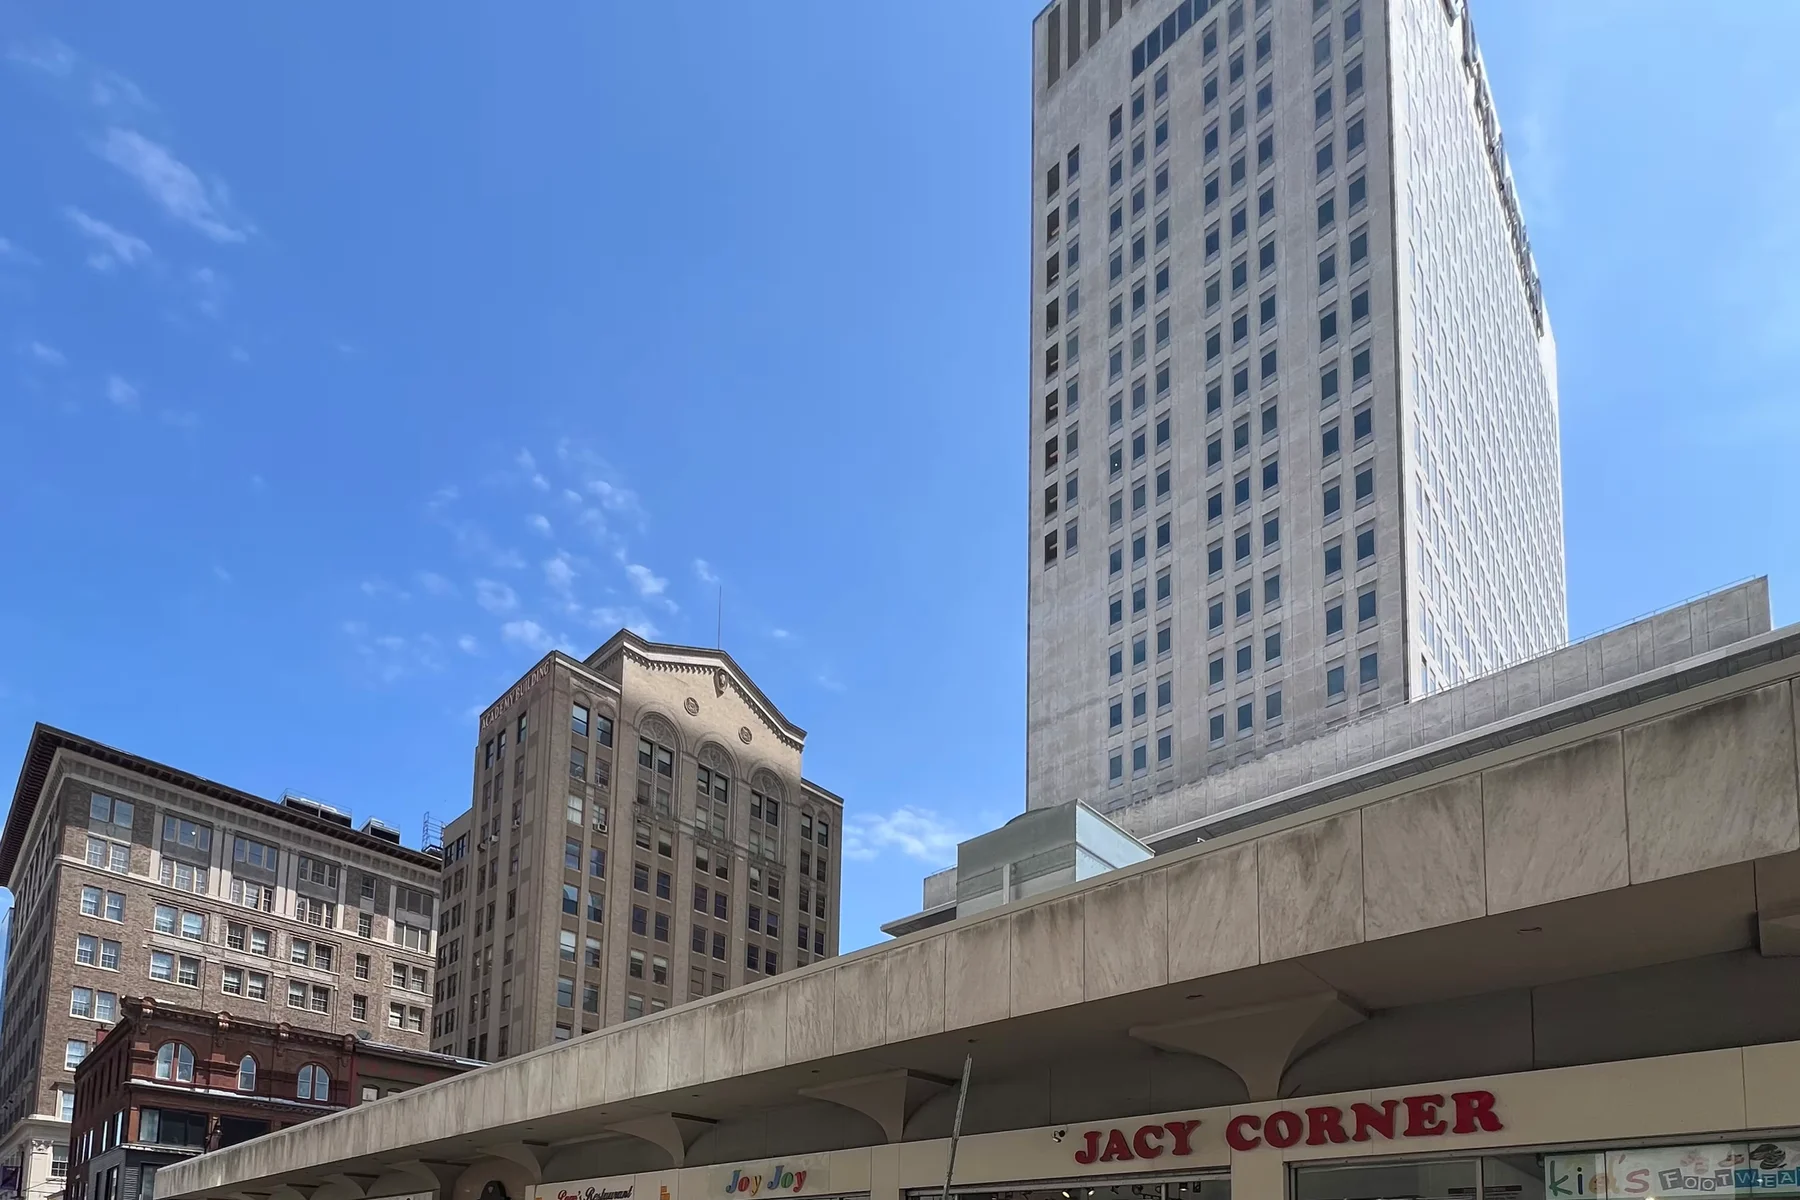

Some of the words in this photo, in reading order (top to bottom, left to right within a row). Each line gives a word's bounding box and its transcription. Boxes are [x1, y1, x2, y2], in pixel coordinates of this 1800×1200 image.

[482, 691, 516, 730] ACADEMY
[515, 659, 550, 701] BUILDING
[1074, 1120, 1202, 1165] JACY
[1225, 1090, 1504, 1152] CORNER
[725, 1169, 762, 1197] Joy
[767, 1165, 807, 1193] Joy
[1659, 1168, 1800, 1192] FOOTWEA
